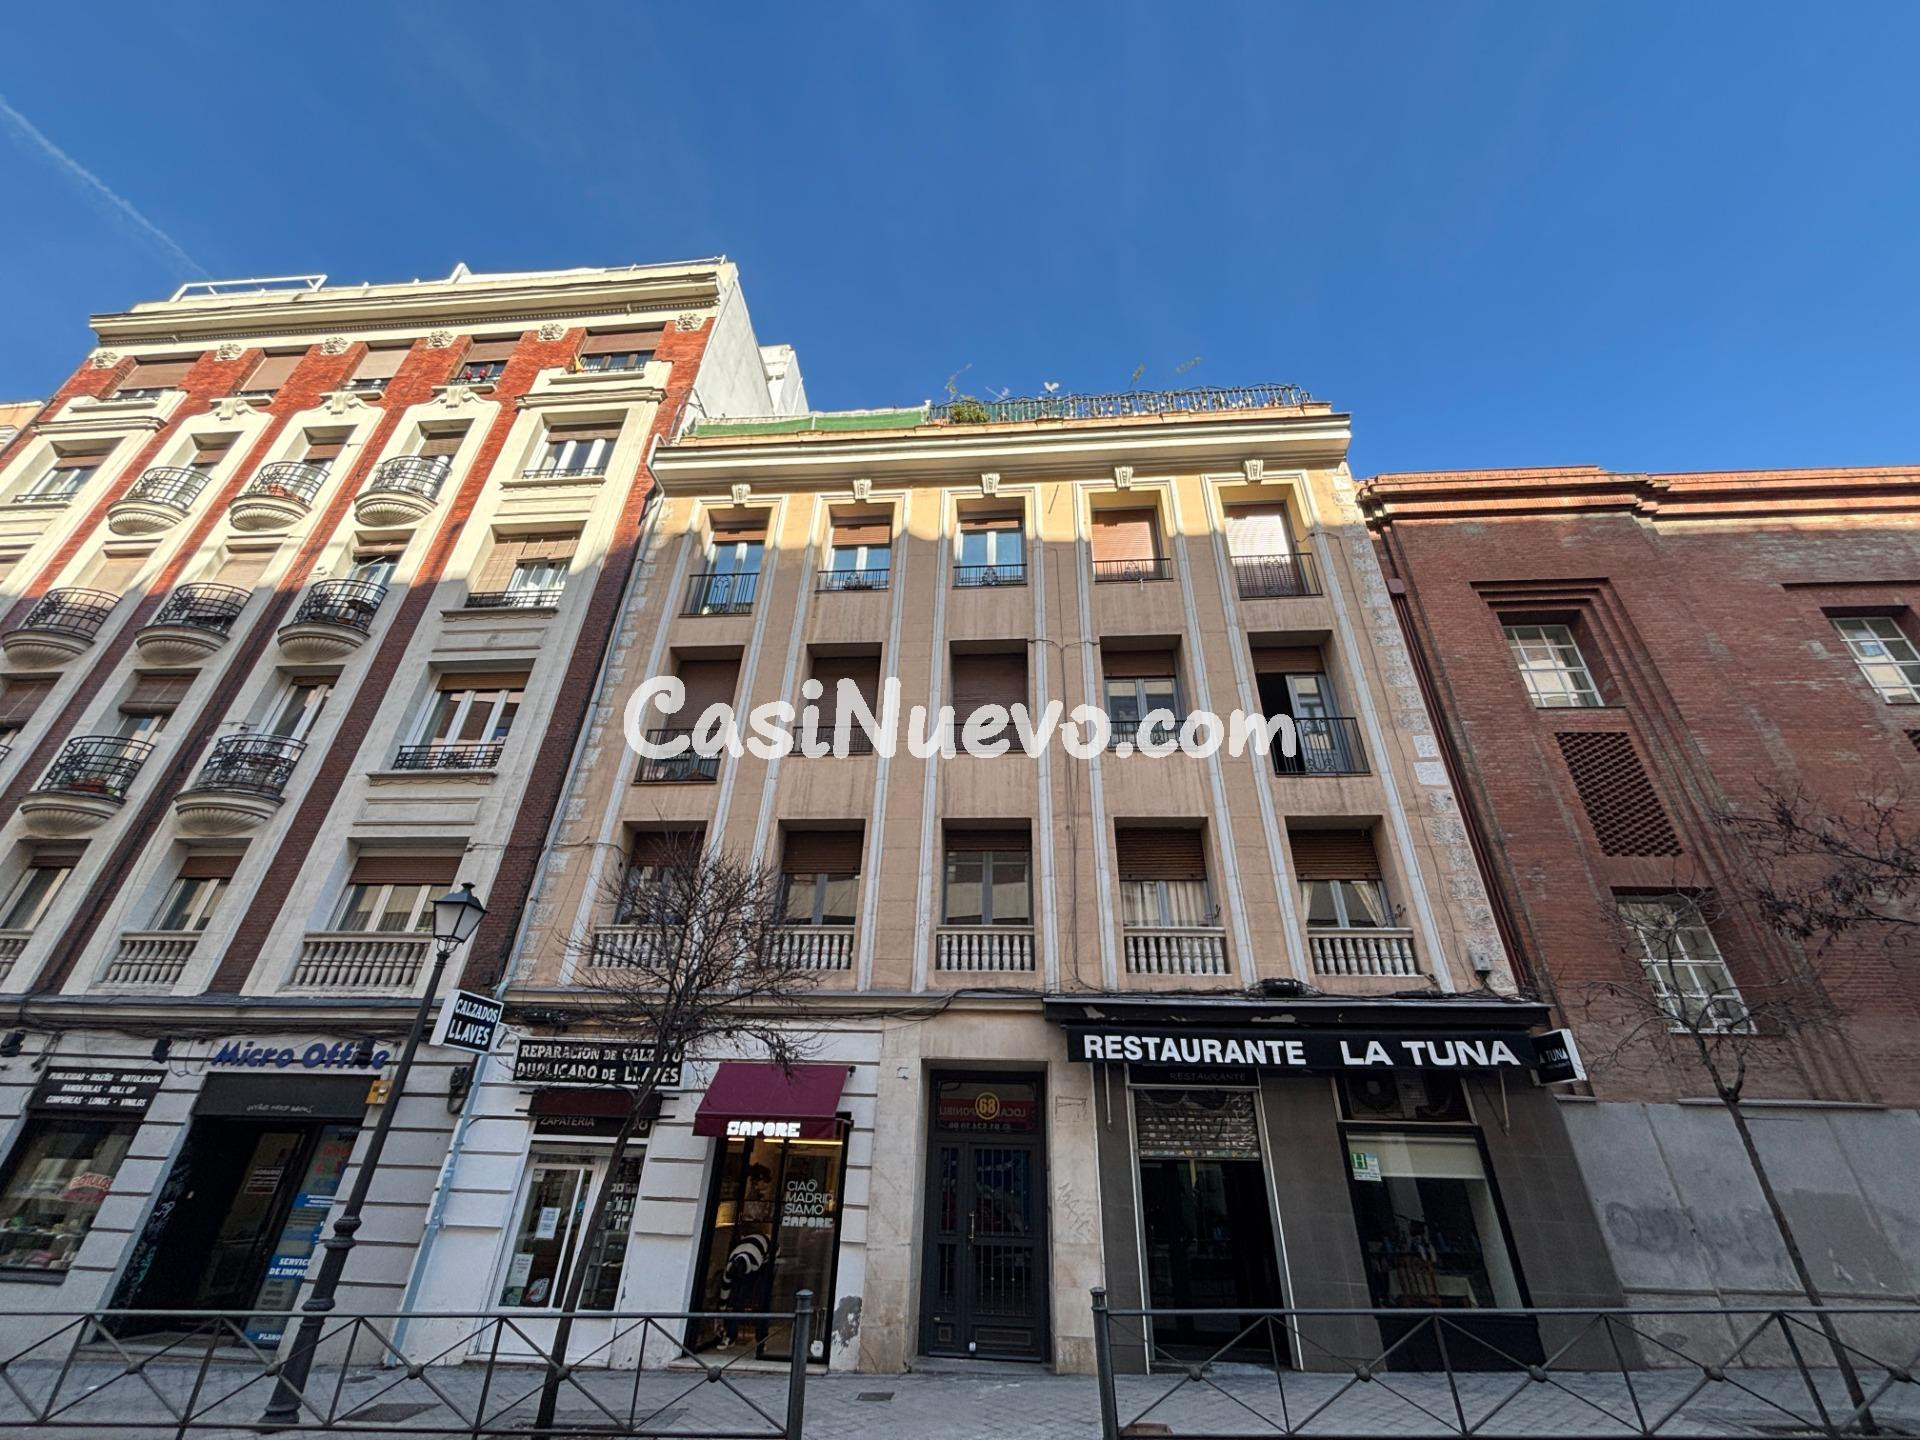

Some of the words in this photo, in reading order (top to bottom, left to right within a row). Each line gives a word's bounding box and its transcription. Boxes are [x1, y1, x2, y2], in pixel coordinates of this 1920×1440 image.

[455, 999, 498, 1024] CALZADOS
[448, 1019, 490, 1046] LLAVES
[211, 1041, 295, 1069] Micro
[302, 1041, 391, 1070] Offe
[603, 1049, 618, 1060] DE
[1083, 1035, 1307, 1066] RESTAURANTE
[1340, 1041, 1394, 1067] LA
[1402, 1041, 1521, 1067] TUNA
[516, 1062, 598, 1079] DUPLICADO
[601, 1068, 617, 1081] DE
[979, 1098, 996, 1114] 68
[726, 1121, 801, 1137] SAPORE
[1353, 1153, 1366, 1168] H
[784, 1203, 824, 1215] SIAMO
